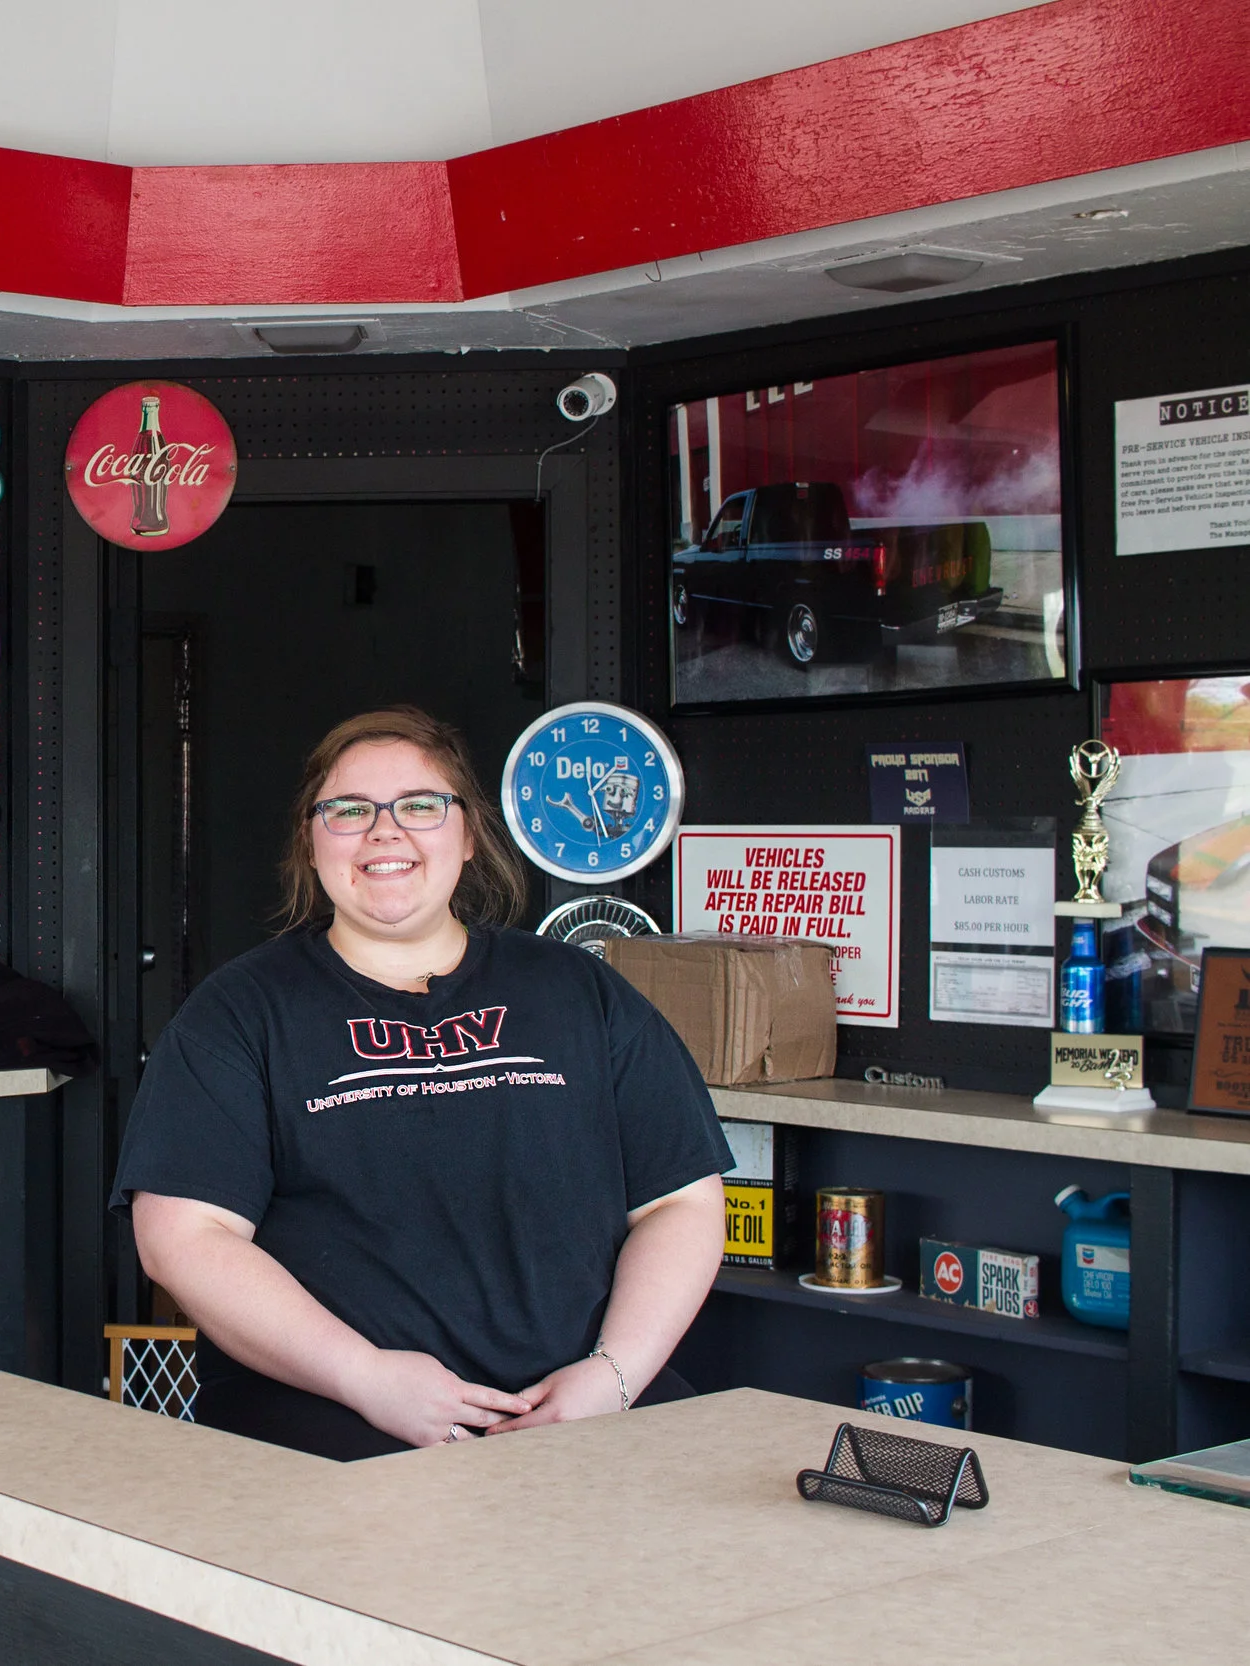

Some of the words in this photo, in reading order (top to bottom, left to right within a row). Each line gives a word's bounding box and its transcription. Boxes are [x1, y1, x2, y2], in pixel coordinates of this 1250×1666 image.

[1160, 394, 1249, 421] NOTICE
[1122, 438, 1187, 454] PRE-SERVICE
[1189, 433, 1229, 446] VEHICLE
[84, 442, 216, 487] Coca-Cola
[1121, 460, 1141, 468] Thank
[1144, 459, 1157, 467] you
[1168, 454, 1198, 463] advance
[1200, 452, 1211, 460] for
[1213, 450, 1226, 458] the
[1228, 448, 1250, 457] oppor
[1121, 470, 1141, 478] serve
[1142, 469, 1155, 477] you
[1157, 466, 1170, 474] and
[1204, 461, 1222, 470] your
[1121, 477, 1165, 488] commitment
[1177, 472, 1206, 483] provide
[1208, 471, 1222, 480] you
[1223, 469, 1236, 477] the
[1238, 468, 1250, 477] hig
[1121, 490, 1129, 498] of
[1150, 486, 1174, 496] please
[1176, 484, 1195, 492] make
[1215, 480, 1232, 488] that
[1121, 499, 1136, 507] free
[1185, 493, 1213, 501] Vehicle
[1215, 489, 1250, 498] Inspectio
[1136, 508, 1155, 516] leave
[1157, 506, 1170, 514] and
[1171, 504, 1196, 512] before
[1198, 503, 1212, 511] you
[1213, 501, 1229, 509] sign
[1231, 499, 1246, 507] any
[1210, 521, 1232, 529] Thank
[823, 547, 842, 560] SS
[912, 556, 973, 588] CHEVROLET
[581, 718, 600, 733] 12
[550, 728, 566, 742] 11
[619, 728, 627, 742] 1
[527, 752, 545, 766] 10
[644, 752, 655, 766] 2
[871, 754, 906, 767] PROUD
[910, 753, 960, 767] SPONSOR
[556, 756, 605, 779] Delo
[521, 786, 532, 800] 9
[653, 786, 664, 800] 3
[903, 806, 935, 815] RAIDERS
[531, 818, 542, 832] 8
[643, 818, 655, 832] 4
[555, 843, 565, 857] 7
[620, 844, 632, 858] 5
[745, 847, 825, 868] VEHICLES
[588, 852, 599, 866] 6
[958, 867, 981, 878] CASH
[983, 868, 1025, 878] CUSTOMS
[706, 869, 744, 889] WILL
[750, 870, 773, 890] BE
[777, 871, 866, 892] RELEASED
[704, 891, 757, 912] AFTER
[761, 893, 823, 914] REPAIR
[828, 895, 866, 916] BILL
[964, 895, 993, 905] LABOR
[995, 895, 1019, 905] RATE
[718, 914, 735, 934] IS
[739, 915, 778, 935] PAID
[782, 916, 801, 936] IN
[805, 917, 851, 939] FULL.
[954, 921, 982, 932] $85.00
[984, 922, 1001, 932] PER
[1003, 923, 1029, 933] HOUR
[832, 945, 861, 959] OPER
[835, 993, 854, 1005] ank
[858, 997, 876, 1008] you
[1055, 1047, 1097, 1064] MEMORIAL
[865, 1066, 944, 1089] Custom
[306, 1085, 394, 1113] UNIVERSITY
[725, 1197, 754, 1210] No.
[759, 1199, 765, 1210] 1
[725, 1214, 740, 1243] NE
[743, 1215, 765, 1244] OIL
[748, 1257, 773, 1266] GALLON
[937, 1261, 960, 1283] AC
[982, 1263, 1020, 1292] SPARK
[894, 1391, 924, 1418] DIP
